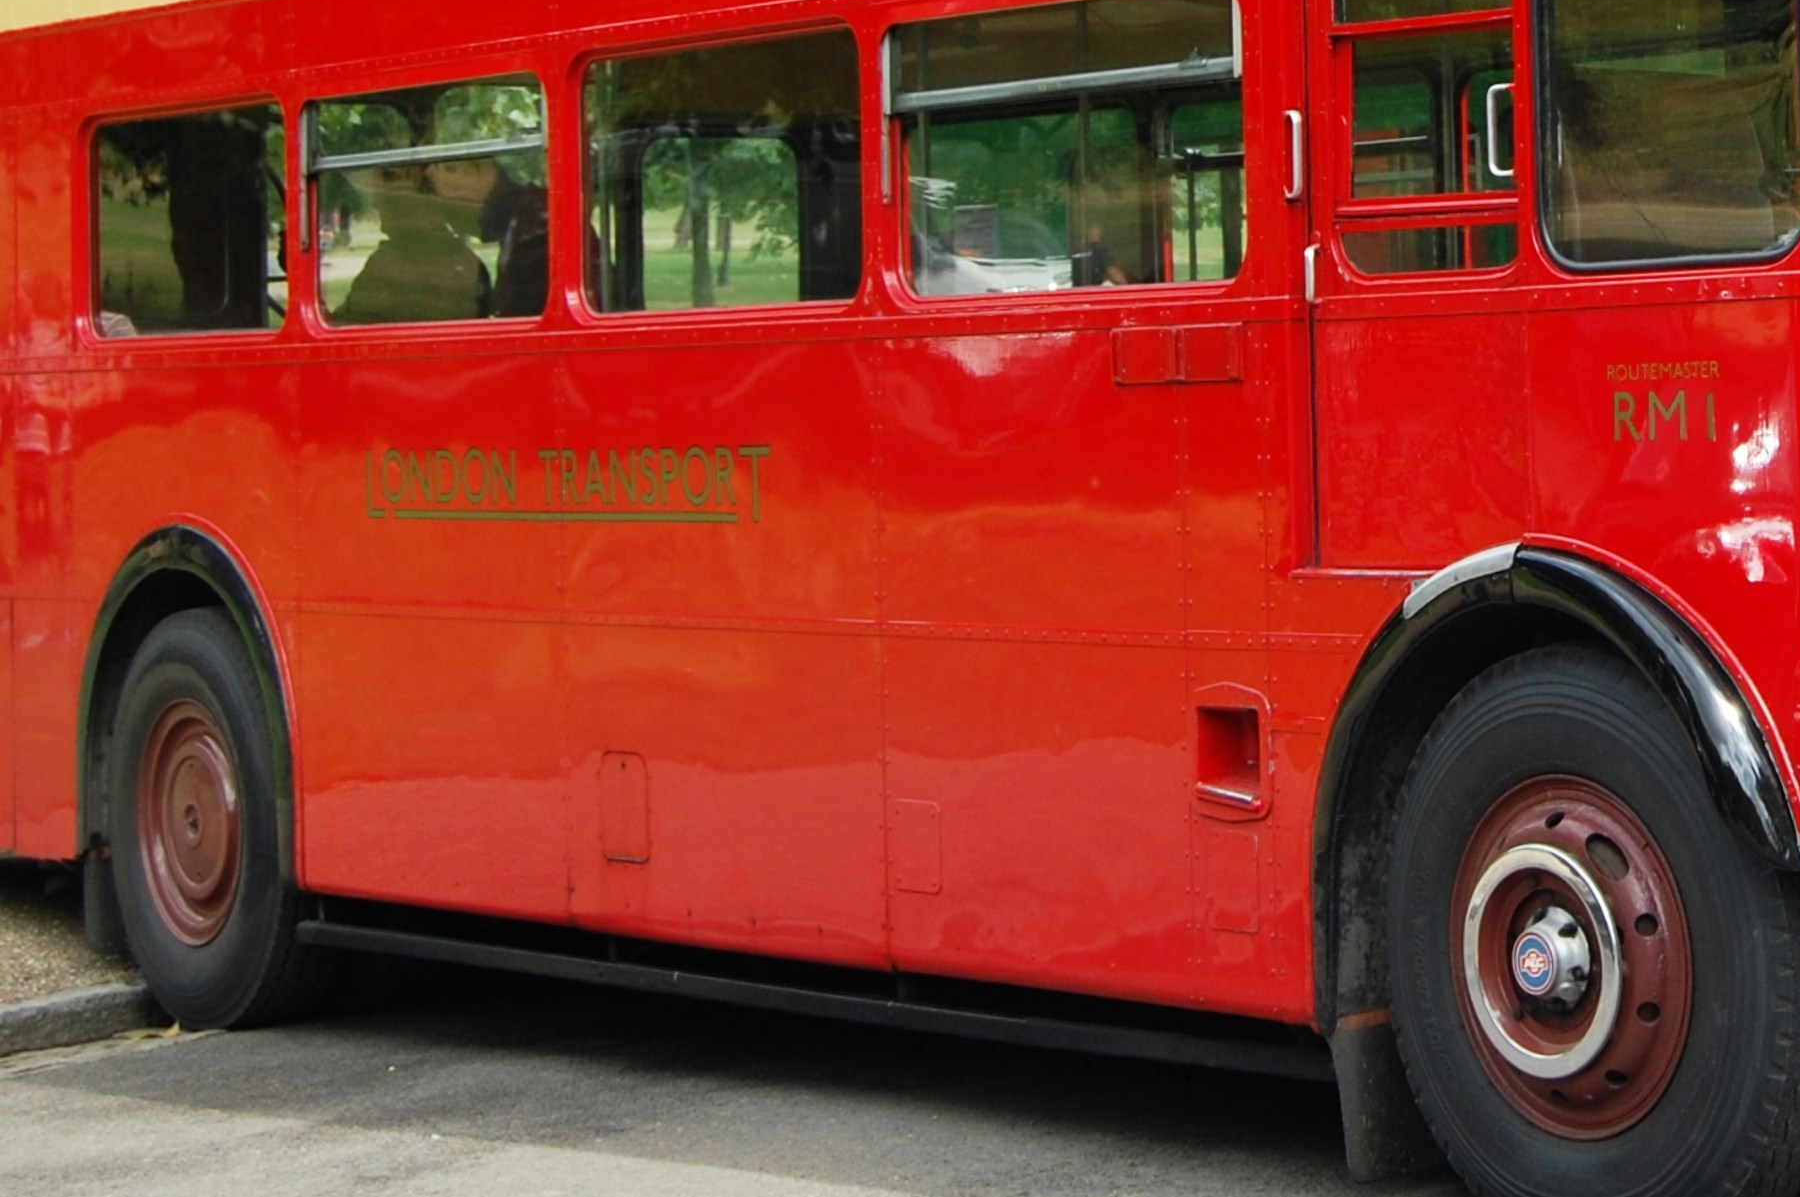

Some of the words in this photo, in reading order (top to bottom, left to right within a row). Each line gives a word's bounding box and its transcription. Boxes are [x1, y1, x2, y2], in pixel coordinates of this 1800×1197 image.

[1606, 360, 1720, 382] ROUTEMASTER
[1613, 389, 1688, 441] RM
[366, 445, 517, 520] LONDON
[537, 444, 772, 524] TRANSPORT
